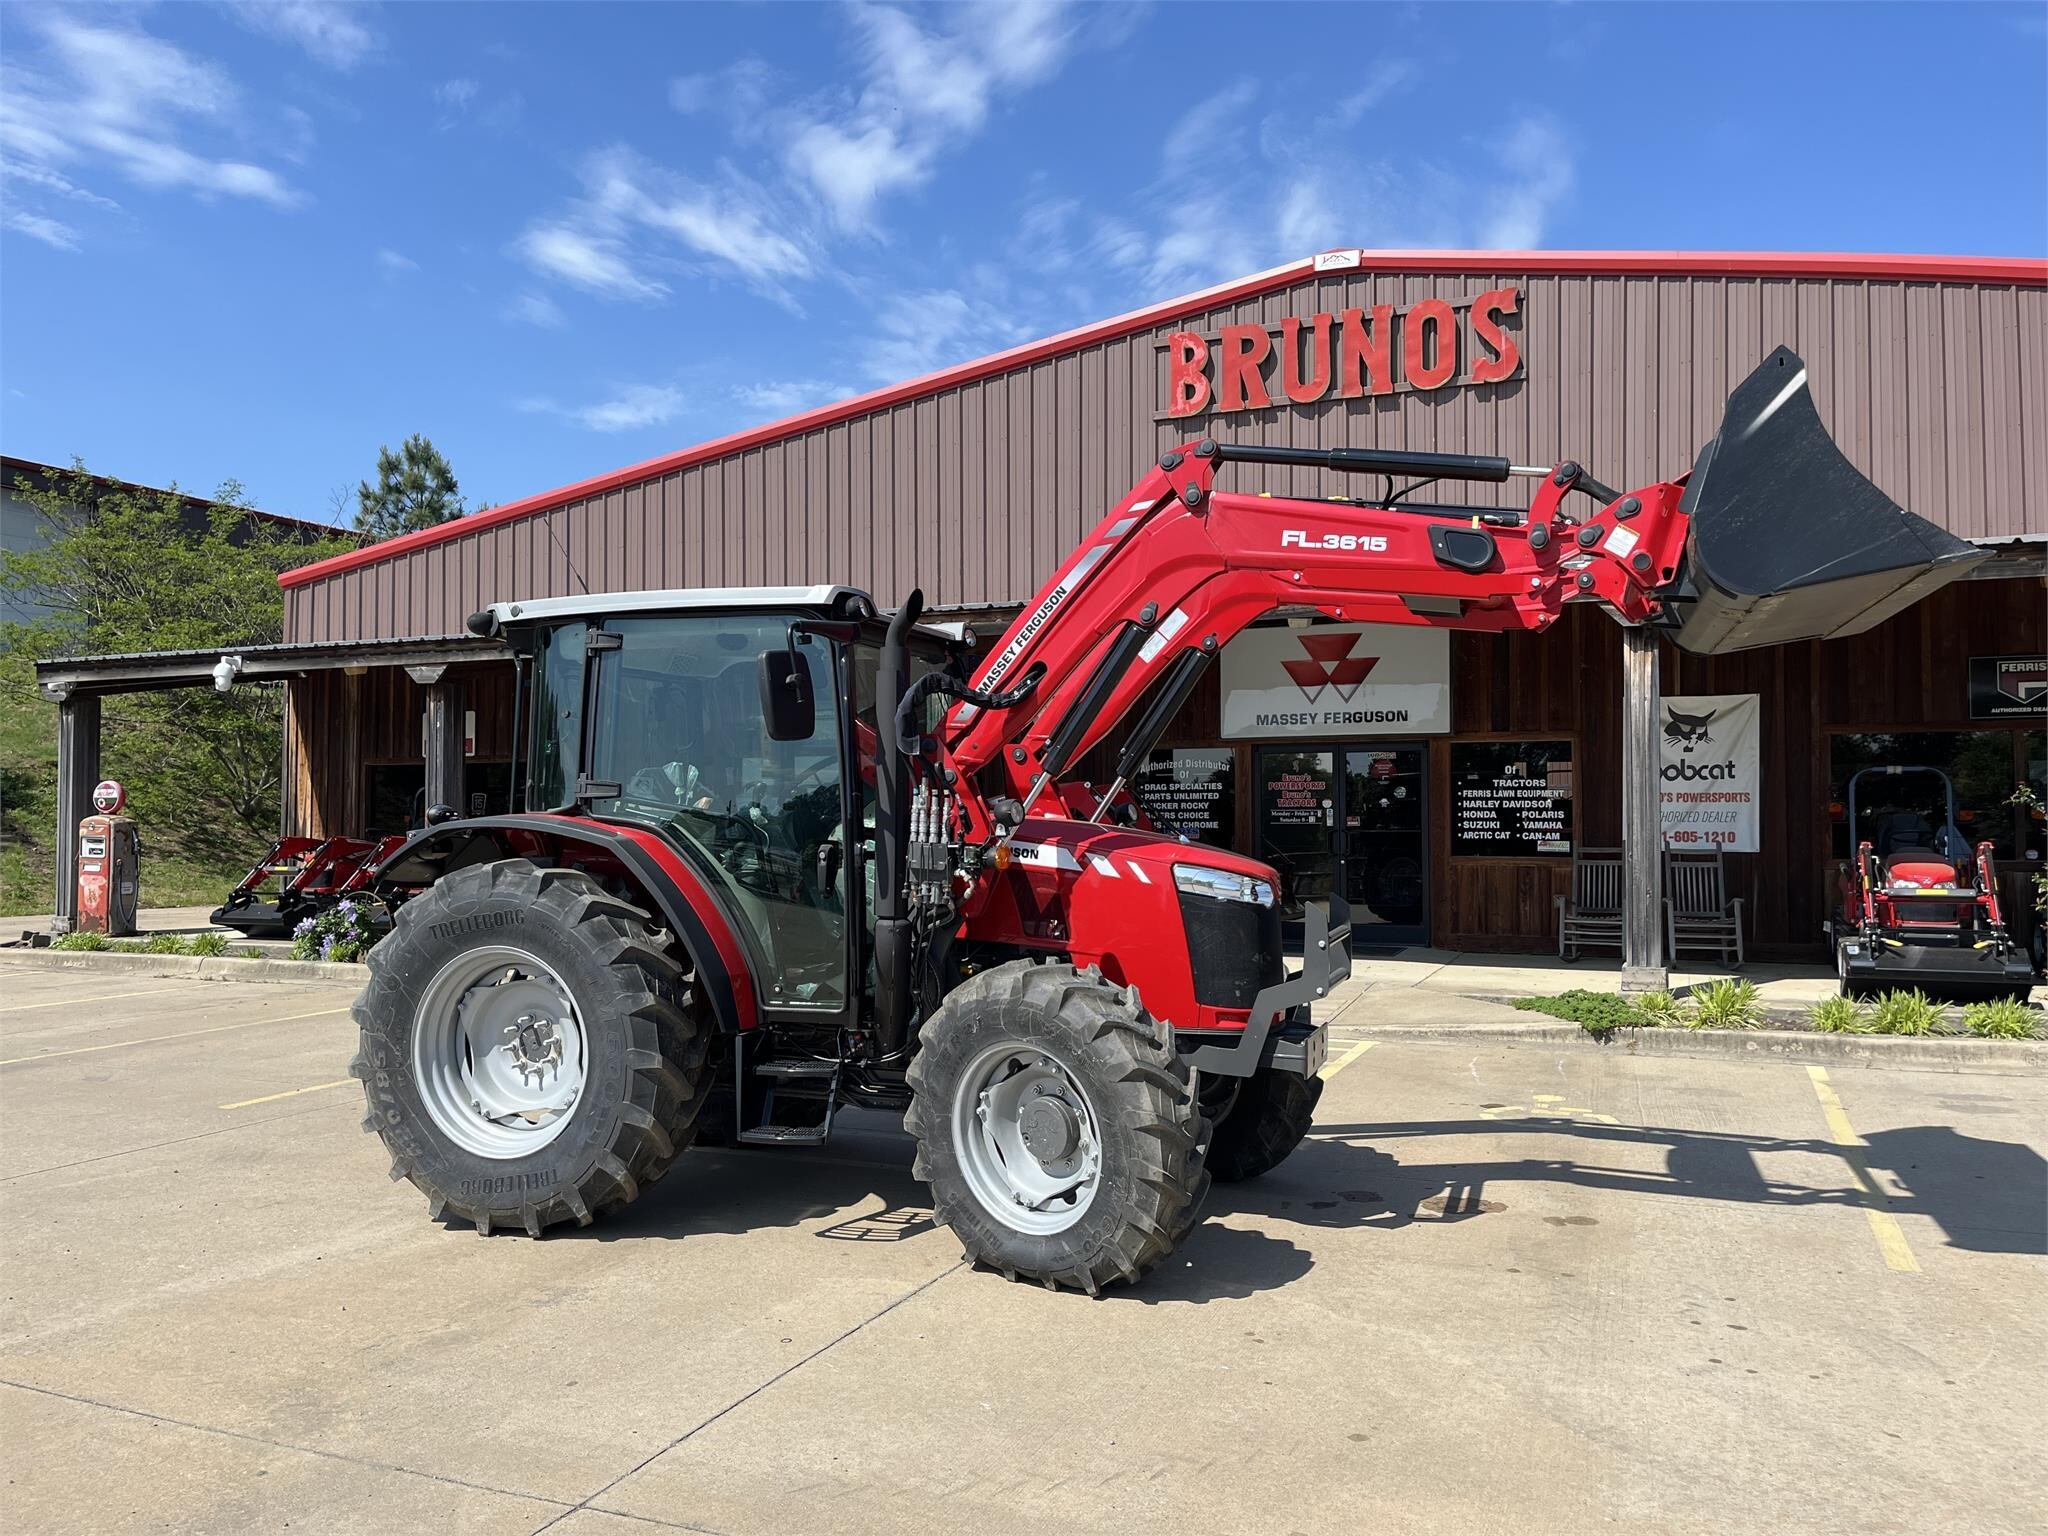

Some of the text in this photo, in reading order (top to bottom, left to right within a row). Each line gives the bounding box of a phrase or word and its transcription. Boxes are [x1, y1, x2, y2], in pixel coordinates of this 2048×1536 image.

[1280, 529, 1388, 553] FL.3615
[978, 585, 1068, 694] MASSEY FERGUSON
[2001, 662, 2047, 672] FERRIS
[1256, 709, 1409, 726] MASSEY FERGUSON
[1140, 759, 1231, 774] Authorized Distributor
[1504, 765, 1517, 775] Of
[1179, 771, 1190, 779] Of
[1144, 782, 1223, 791] DRAG SPECIALTIES
[1268, 782, 1326, 790] POWERSPORTS
[1492, 779, 1546, 787] TRACTORS
[1144, 792, 1220, 800] PARTS UNLIMITED
[1462, 789, 1565, 798] FERRIS LAWN EQUIPMENT
[1676, 792, 1751, 803] POWERSPORTS
[1181, 802, 1210, 810] ROCKY
[1276, 798, 1317, 807] TRACTORS
[1462, 800, 1552, 808] HARLEY DAVIDSON
[1177, 811, 1210, 819] CHOICE
[1462, 810, 1497, 818] HONDA
[1522, 810, 1565, 819] POLARIS
[1701, 811, 1737, 823] DEALER
[1182, 821, 1219, 829] CHROME
[1462, 821, 1500, 829] SUZUKI
[1522, 821, 1563, 829] YAMAHA
[1462, 831, 1511, 839] ARCTIC CAT
[1522, 832, 1561, 840] CAN-AM
[1661, 830, 1736, 843] 1-605-1210
[428, 907, 526, 941] TRELLEBORG
